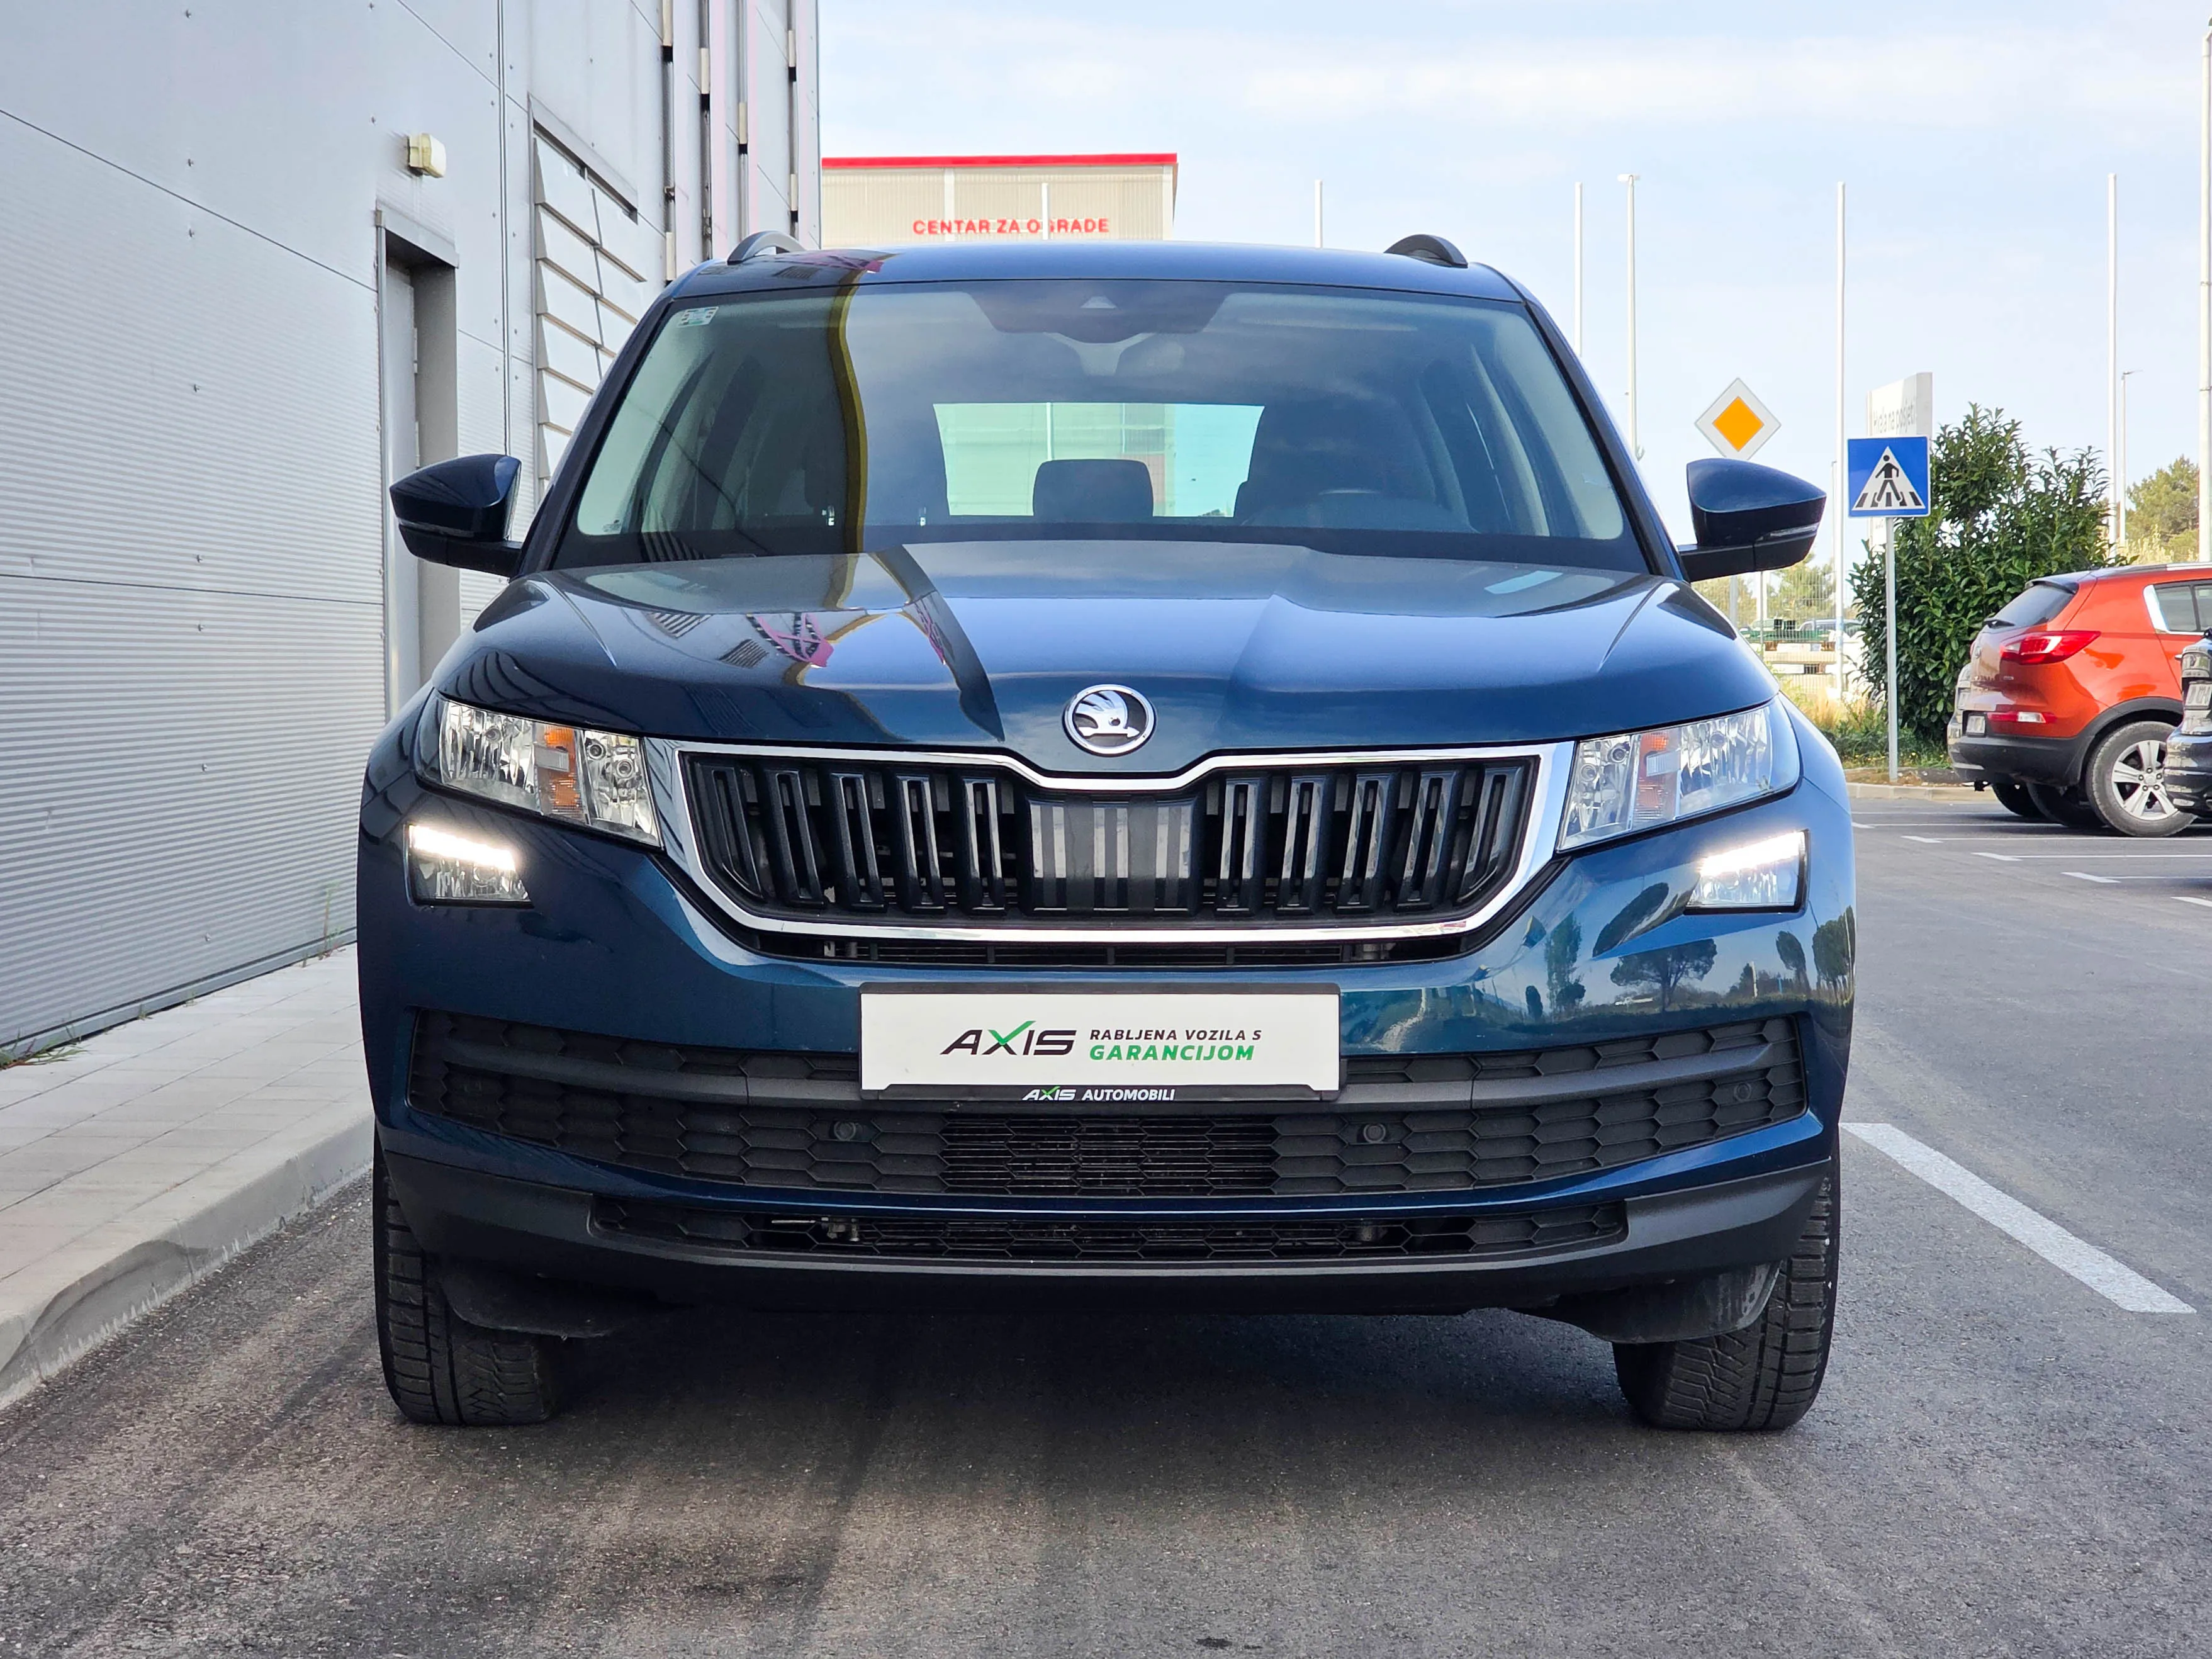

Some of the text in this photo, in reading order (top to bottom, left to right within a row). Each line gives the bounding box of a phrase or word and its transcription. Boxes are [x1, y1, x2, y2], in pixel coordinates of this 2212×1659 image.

[912, 218, 991, 235] CENTAR
[996, 218, 1020, 234] ZA
[940, 1020, 1077, 1056] AXIS
[1089, 1029, 1262, 1040] RABLJENA VOZILA S
[1089, 1045, 1255, 1060] GARANCIJOM
[1021, 1086, 1176, 1101] AXIS AUTOMOBILI
